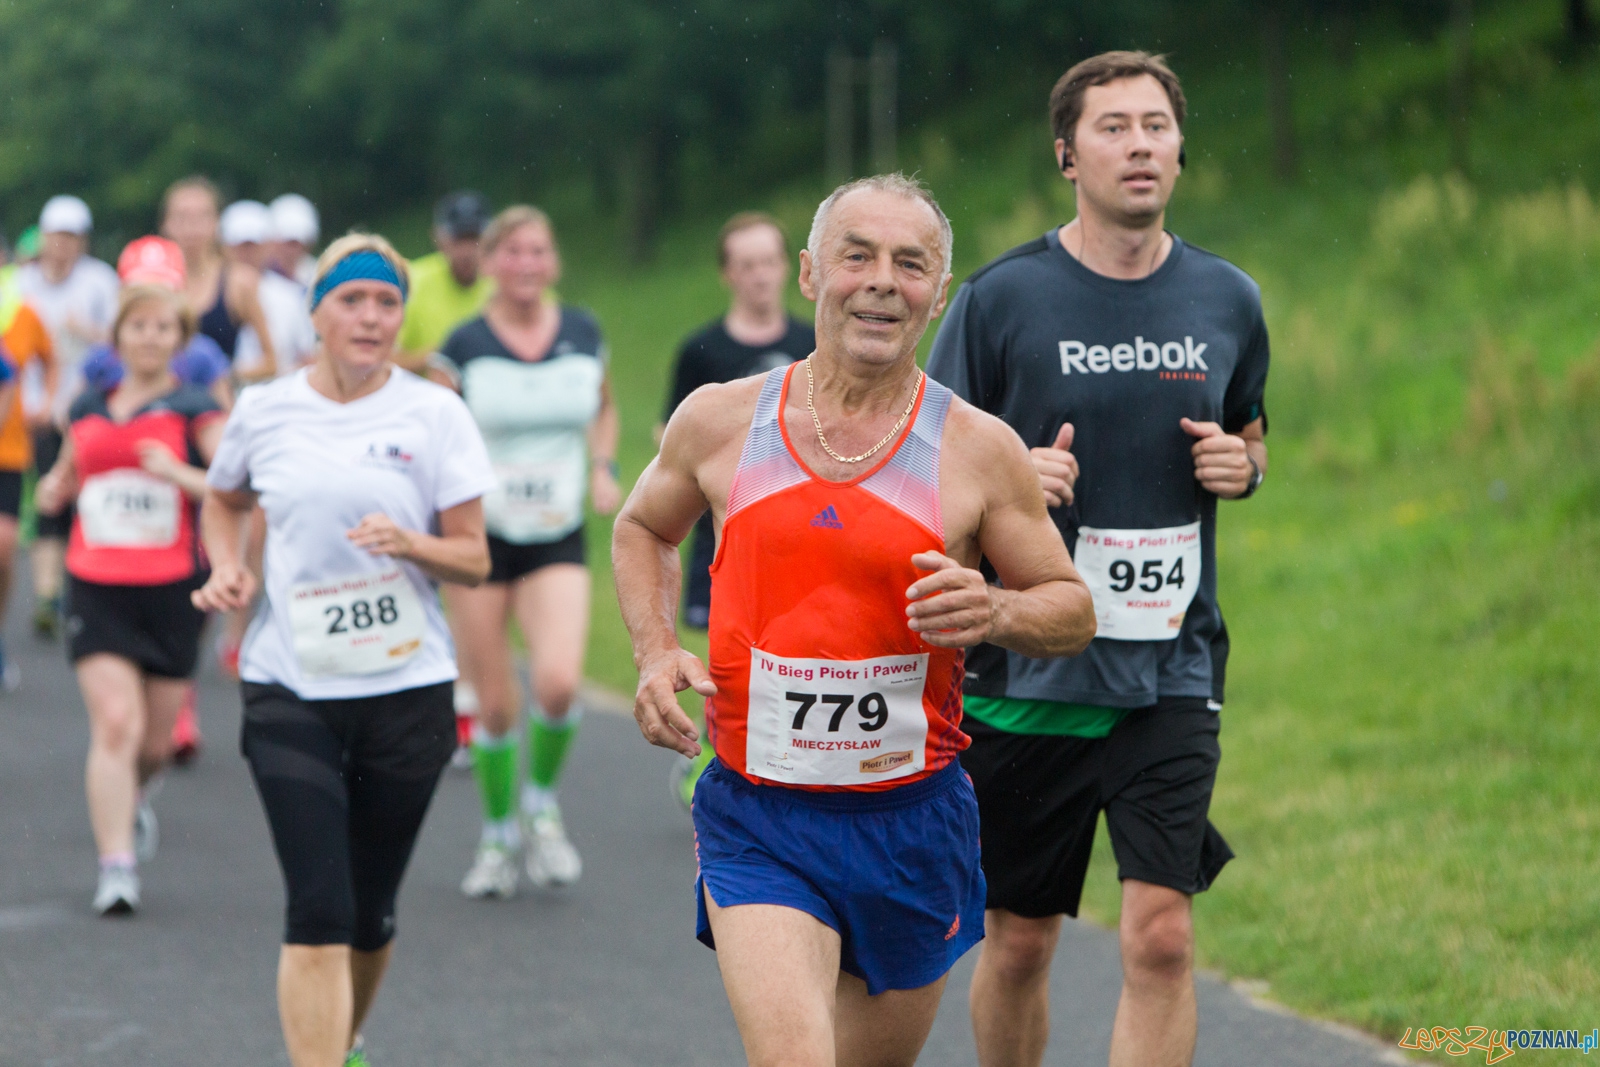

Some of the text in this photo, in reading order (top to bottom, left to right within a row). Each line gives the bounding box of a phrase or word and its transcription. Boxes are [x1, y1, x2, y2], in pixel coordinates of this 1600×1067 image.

[1058, 335, 1209, 375] Reebok
[1108, 556, 1185, 593] 954
[324, 594, 398, 634] 288
[761, 658, 918, 681] IV Bieg Piotr i Paweł
[785, 691, 888, 732] 779
[792, 739, 881, 750] MIECZYSŁAW
[862, 761, 882, 770] Piotr
